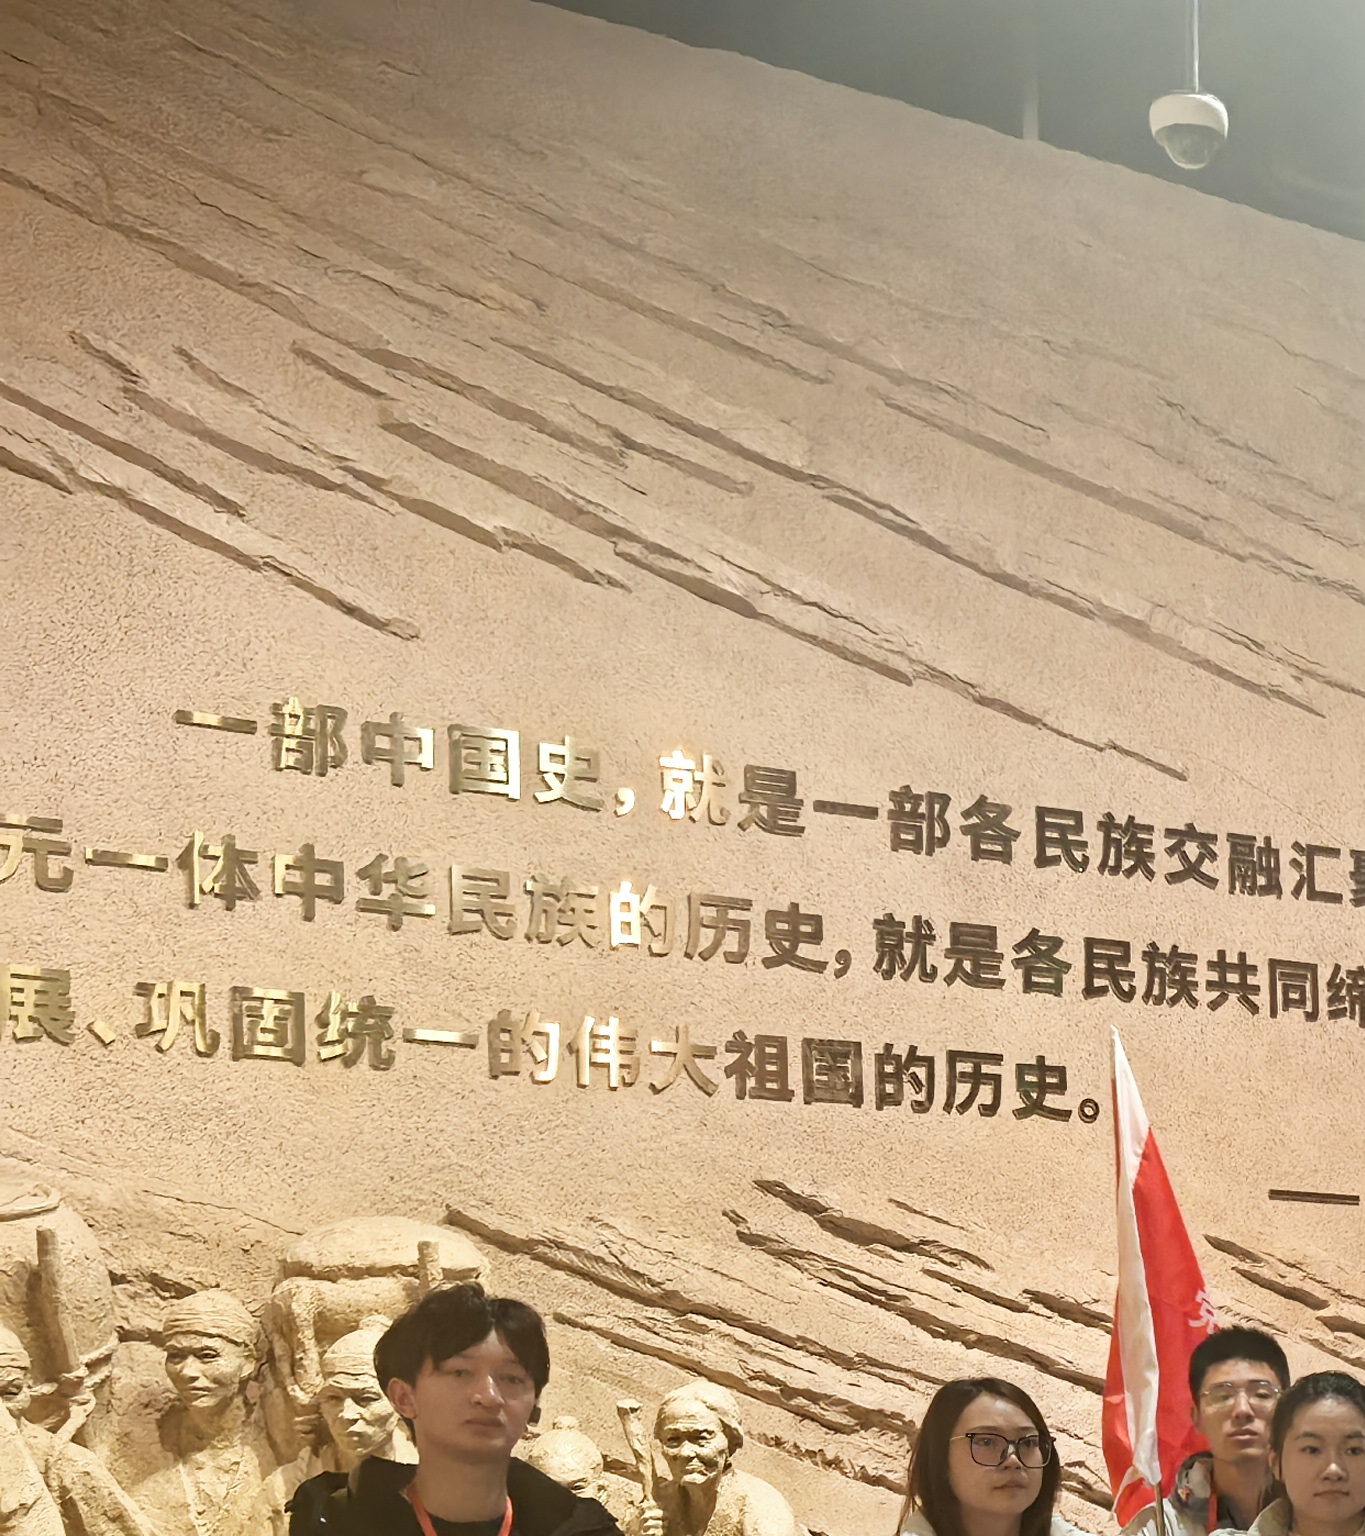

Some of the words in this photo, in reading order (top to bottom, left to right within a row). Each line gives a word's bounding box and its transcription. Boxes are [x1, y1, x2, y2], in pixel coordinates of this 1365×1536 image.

[0, 964, 1101, 1124] 展、巩固统一的伟大祖国的历史。
